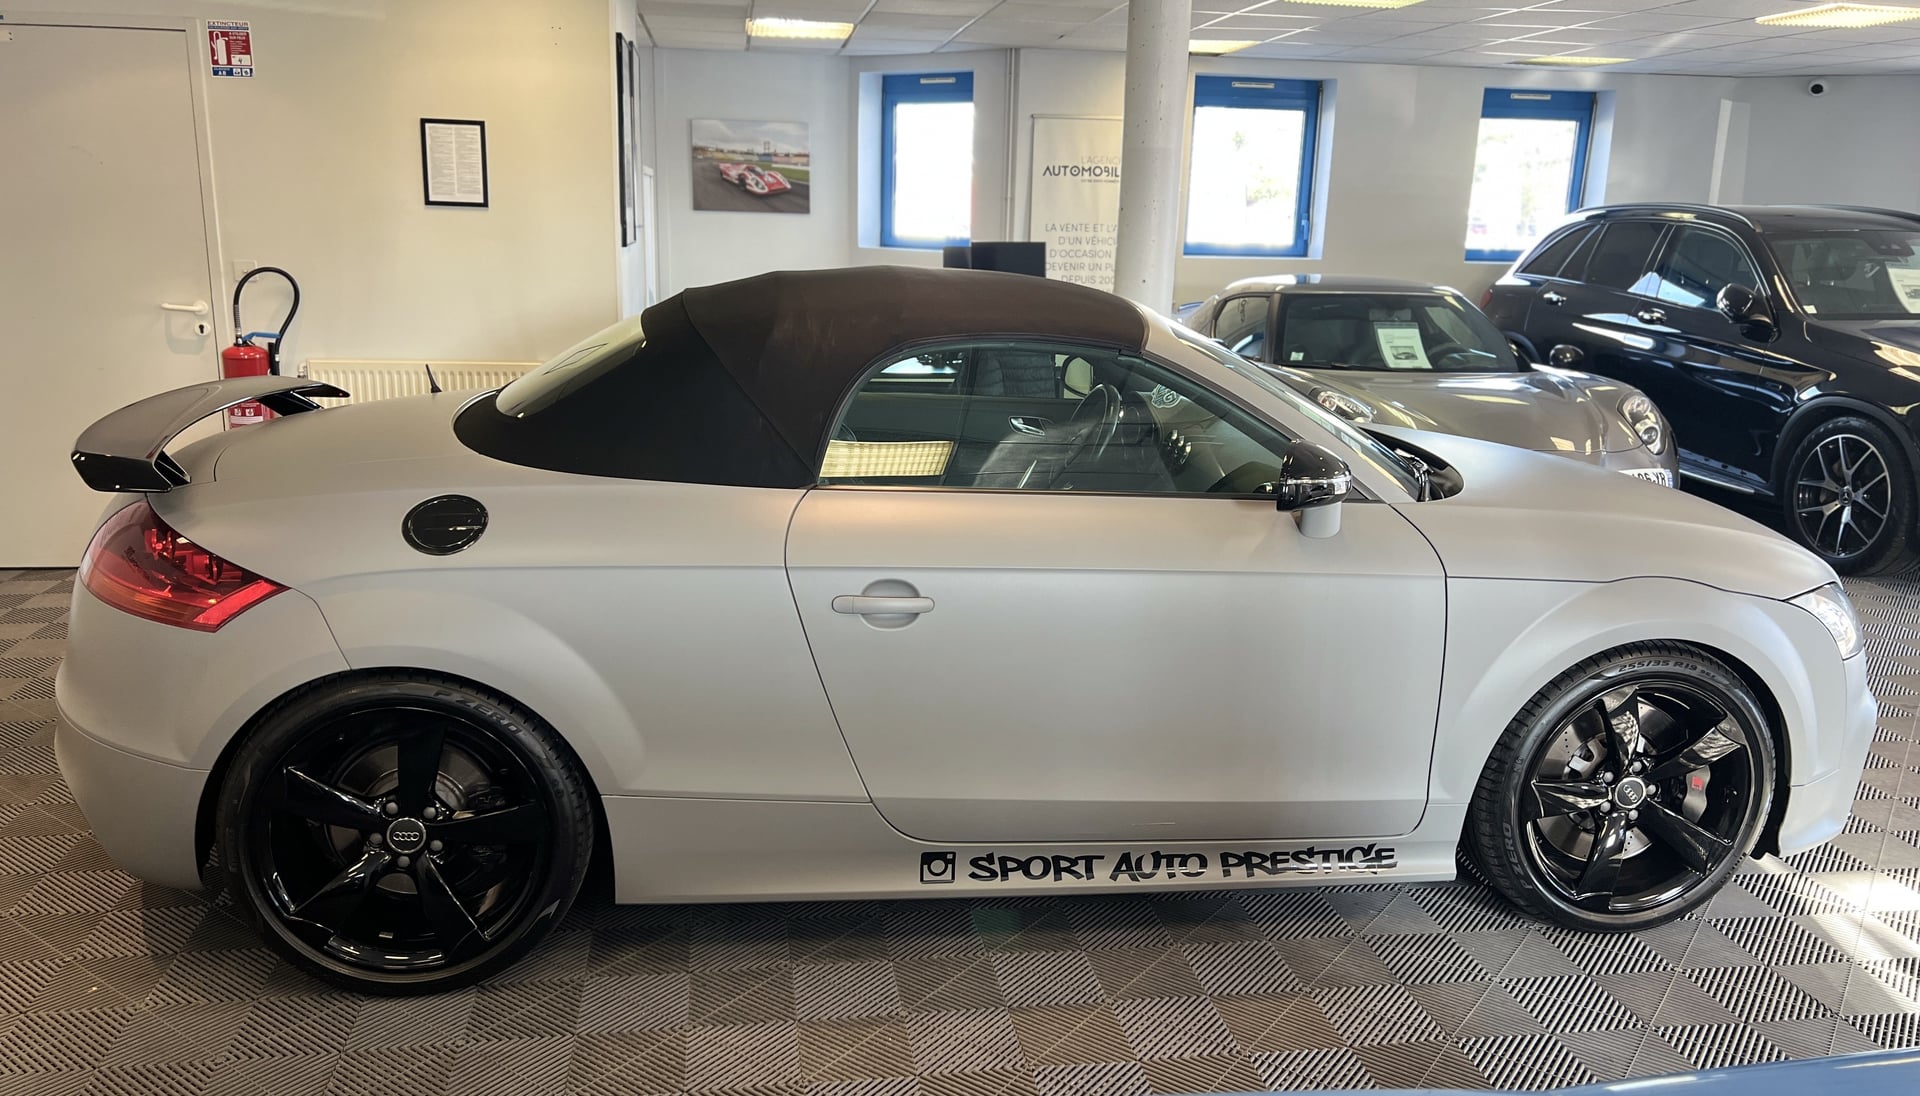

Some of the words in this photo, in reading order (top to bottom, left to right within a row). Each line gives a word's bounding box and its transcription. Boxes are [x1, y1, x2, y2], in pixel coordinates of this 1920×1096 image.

[1045, 223, 1057, 232] LA
[1059, 223, 1090, 233] VENTE
[1093, 223, 1105, 233] ET
[1058, 236, 1082, 246] D'UN
[1049, 249, 1112, 258] D'OCCASION
[1088, 262, 1102, 271] UN
[1061, 275, 1097, 285] DEPUIS
[1618, 660, 1671, 673] 255/35
[1673, 661, 1698, 671] R19
[456, 697, 523, 735] ZERO
[1502, 822, 1524, 876] ZERO
[968, 852, 1105, 882] SPORT
[1110, 851, 1208, 882] AUTO
[1221, 844, 1398, 879] PRESTIGE
